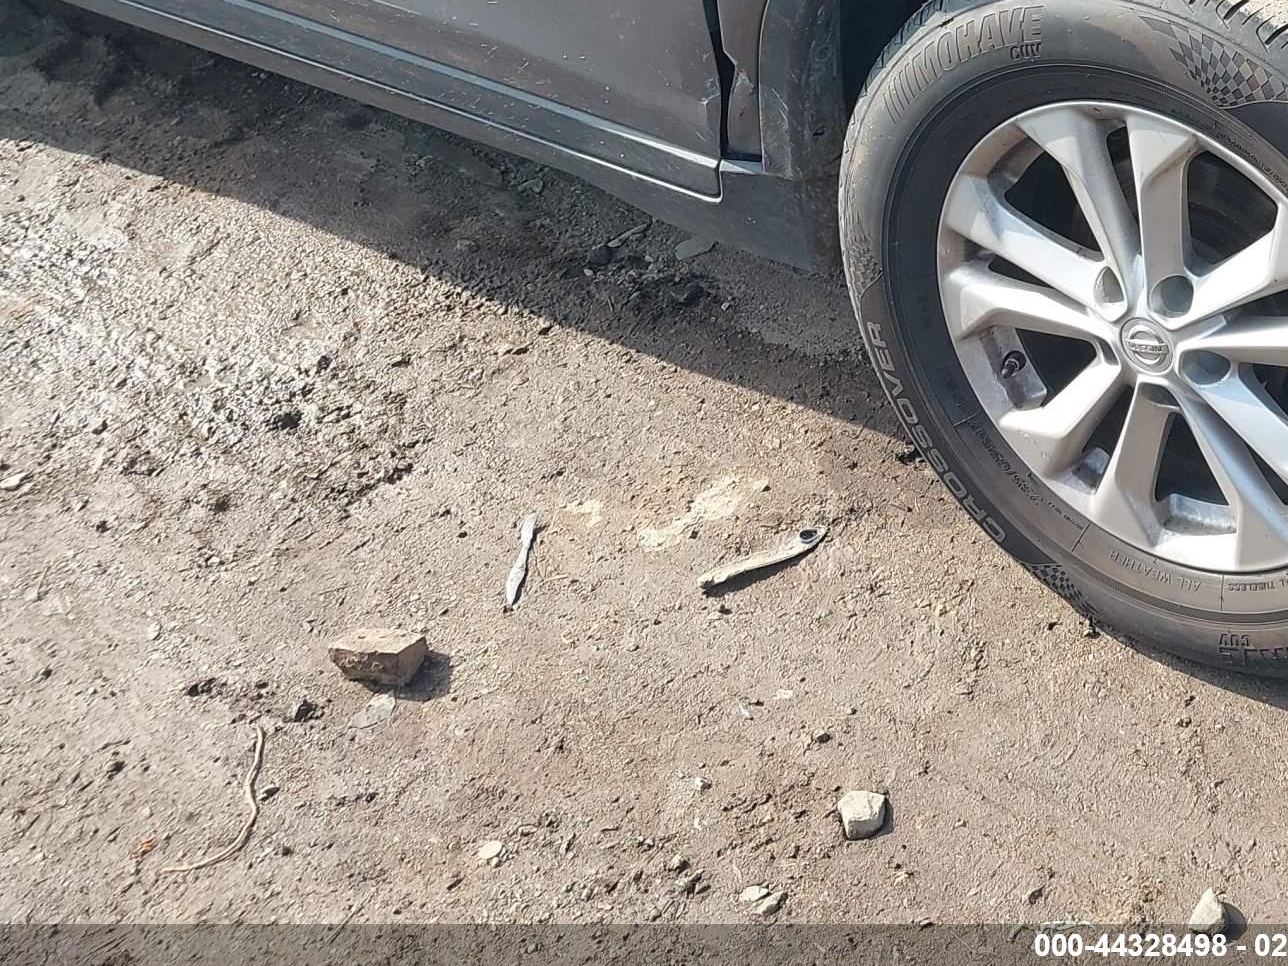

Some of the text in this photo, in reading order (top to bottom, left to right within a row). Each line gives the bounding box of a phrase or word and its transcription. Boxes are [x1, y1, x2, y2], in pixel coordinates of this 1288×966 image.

[911, 5, 1045, 91] MOHAVE
[1009, 42, 1042, 61] CUV
[866, 321, 1007, 545] CROSSOVER
[1108, 548, 1203, 593] ALL WEATHER
[1227, 579, 1277, 592] TUBELESS
[1217, 632, 1251, 647] CUV
